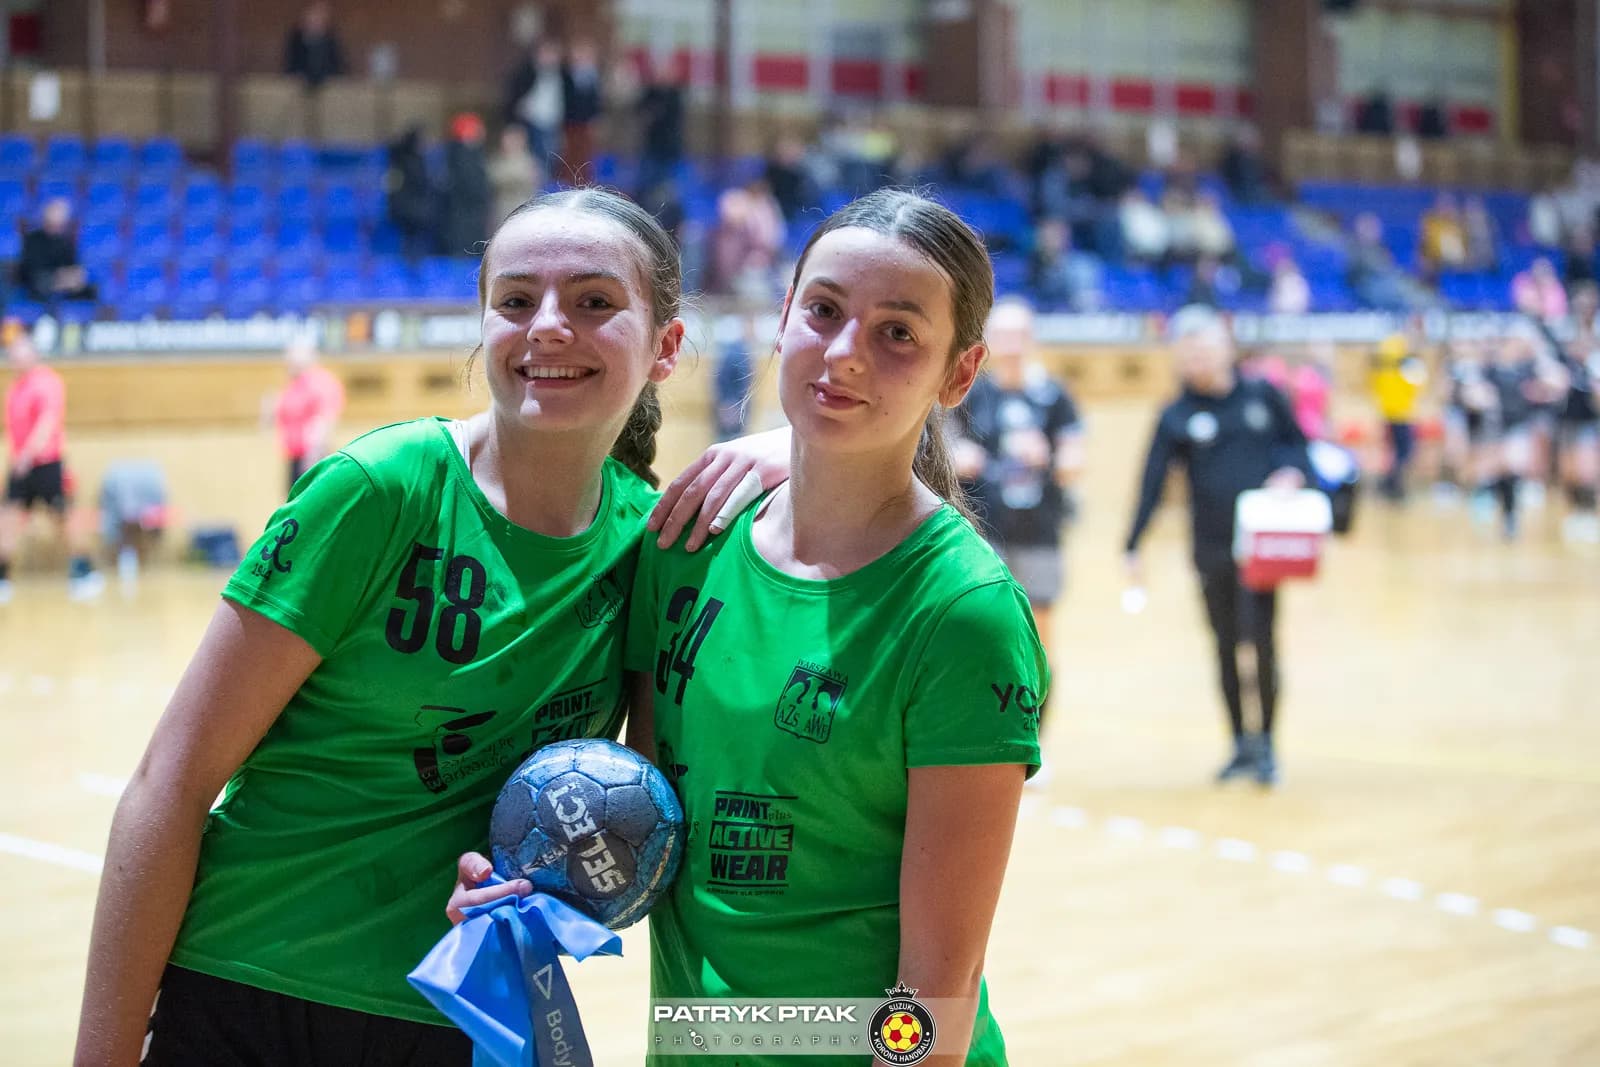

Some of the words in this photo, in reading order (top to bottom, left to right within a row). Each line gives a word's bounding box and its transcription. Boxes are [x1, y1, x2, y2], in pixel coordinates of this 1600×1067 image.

[384, 543, 487, 665] 58
[655, 585, 725, 707] 34
[797, 658, 849, 686] WARSZAWA
[534, 690, 593, 724] PRINT
[777, 703, 801, 728] AZS
[803, 713, 829, 739] AWF
[714, 797, 771, 821] PRINT
[545, 781, 627, 893] SELECT
[710, 824, 792, 849] ACTIVE
[711, 852, 789, 881] WEAR
[546, 1008, 575, 1067] Body
